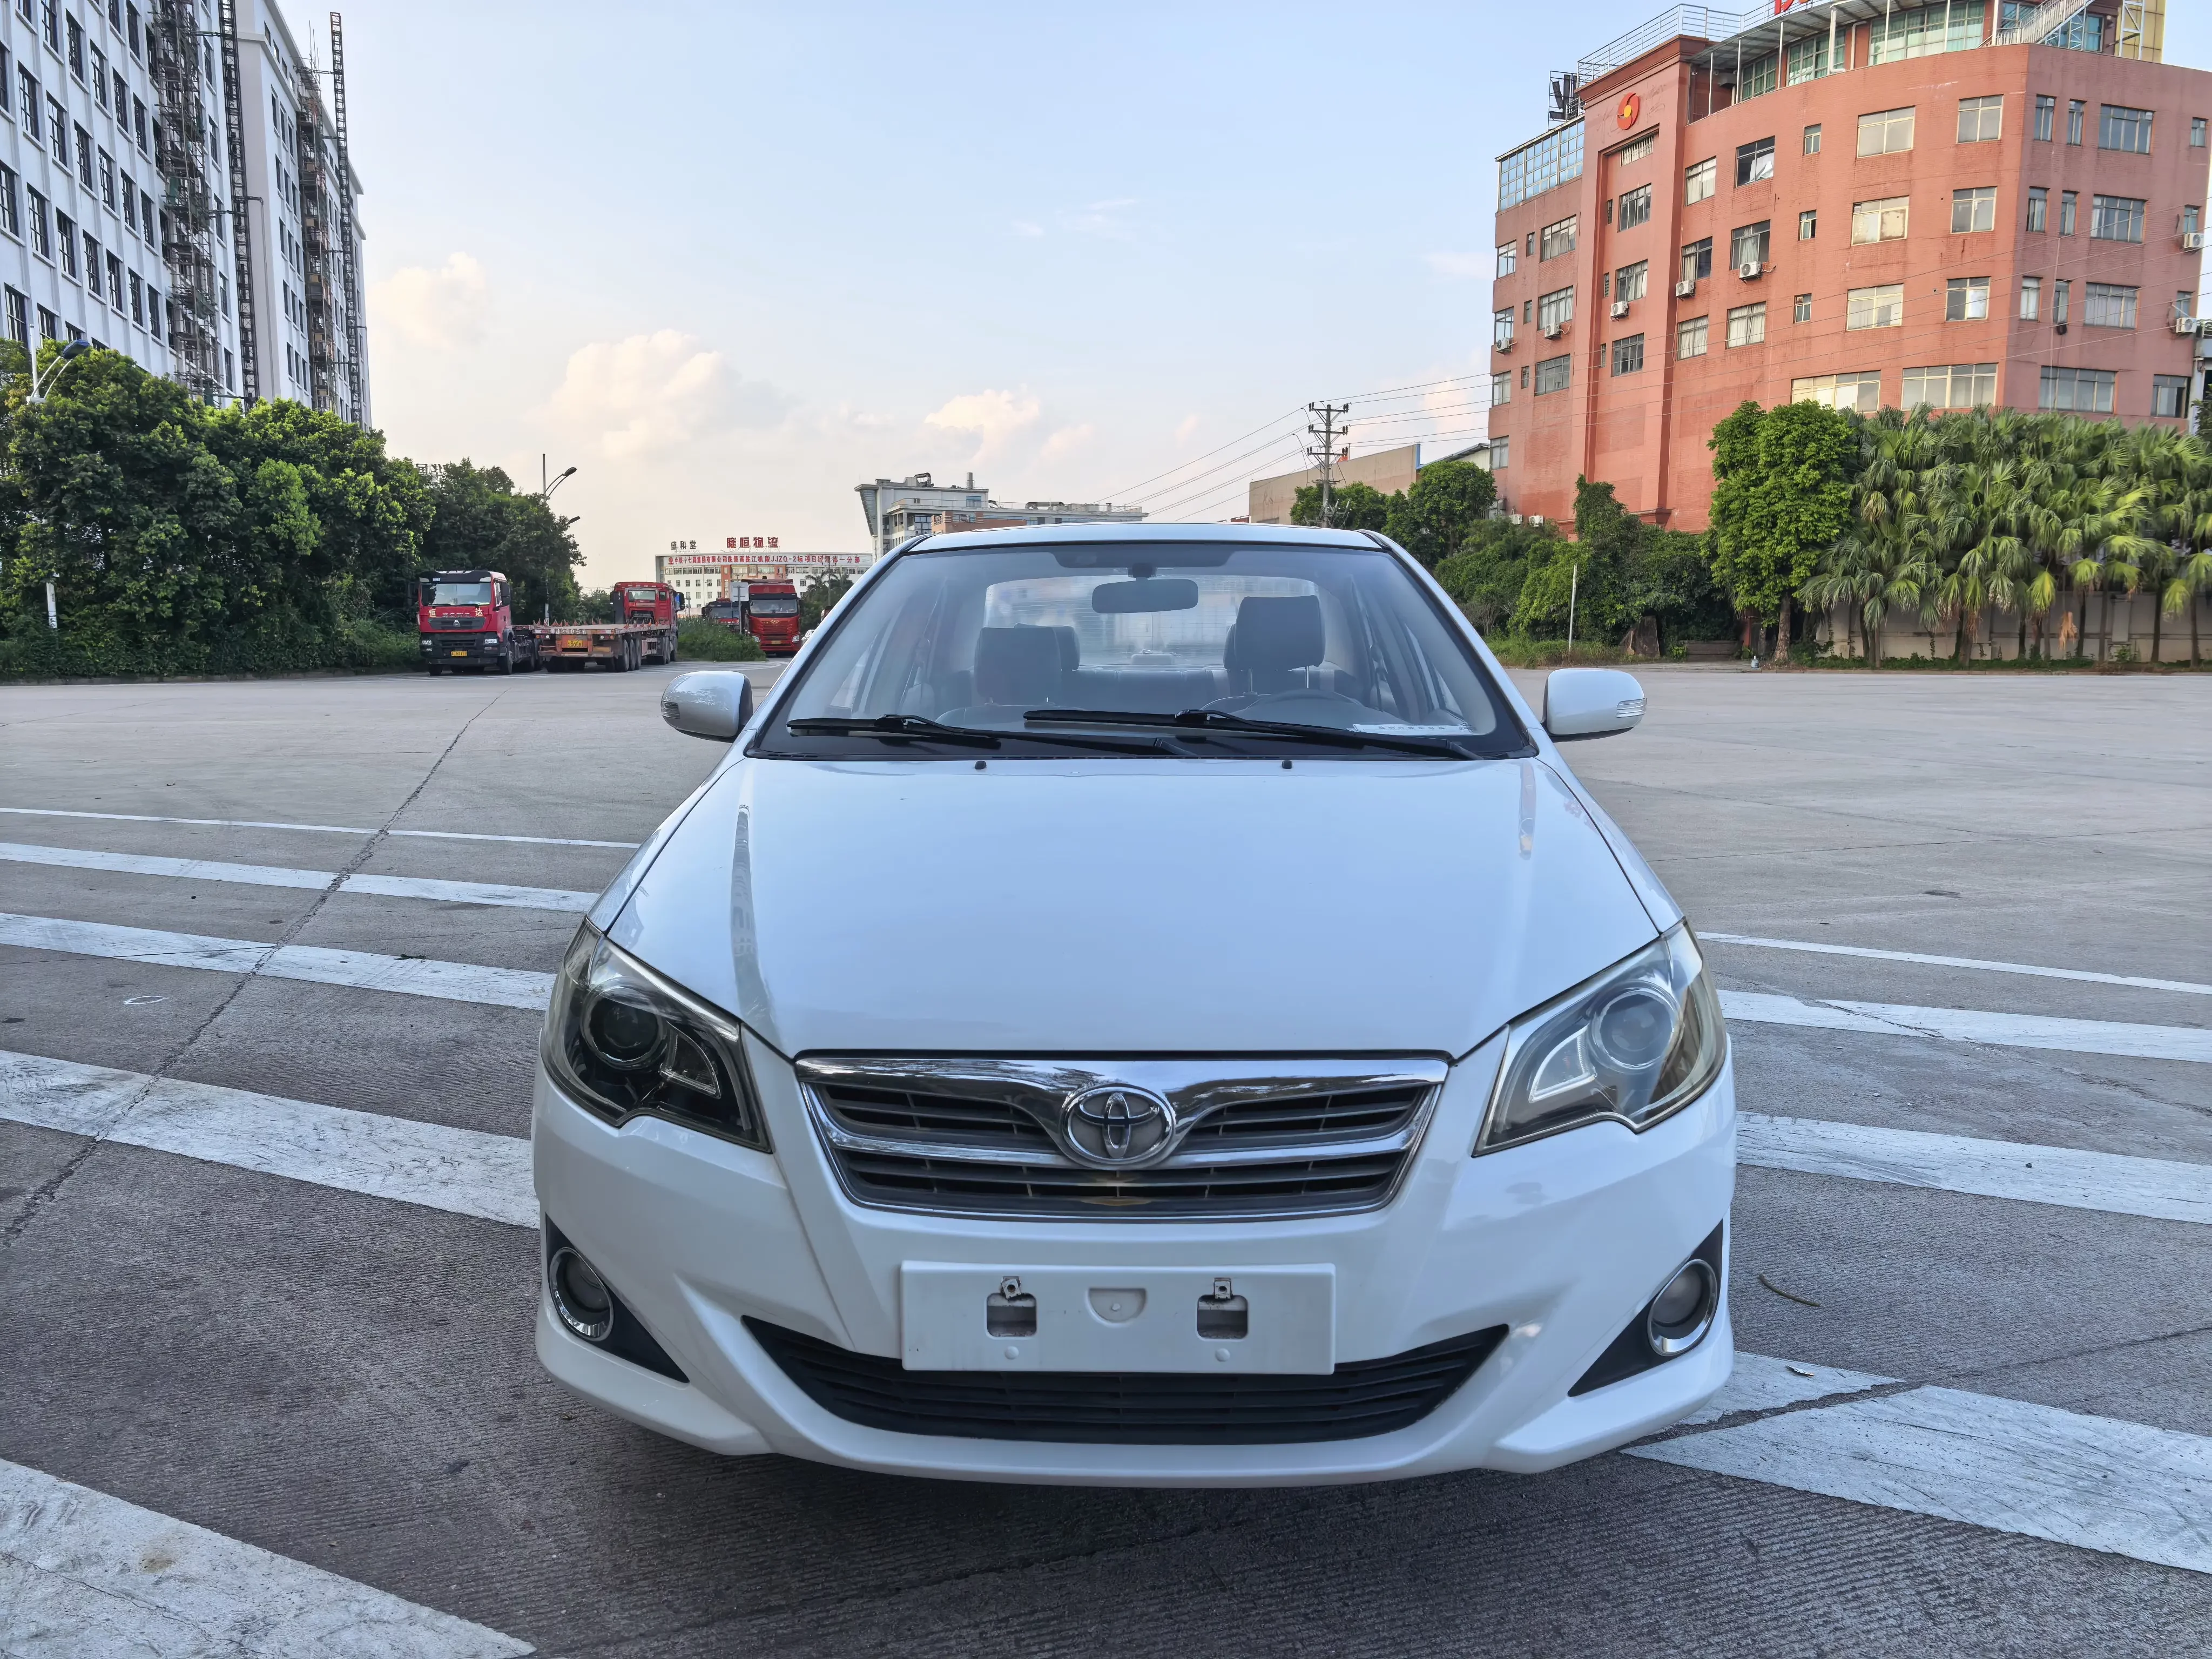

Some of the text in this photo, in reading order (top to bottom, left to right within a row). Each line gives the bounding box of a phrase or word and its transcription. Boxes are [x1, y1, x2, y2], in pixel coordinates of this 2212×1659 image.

[671, 540, 697, 550] 盛和堂
[726, 537, 778, 548] 隆恒物流
